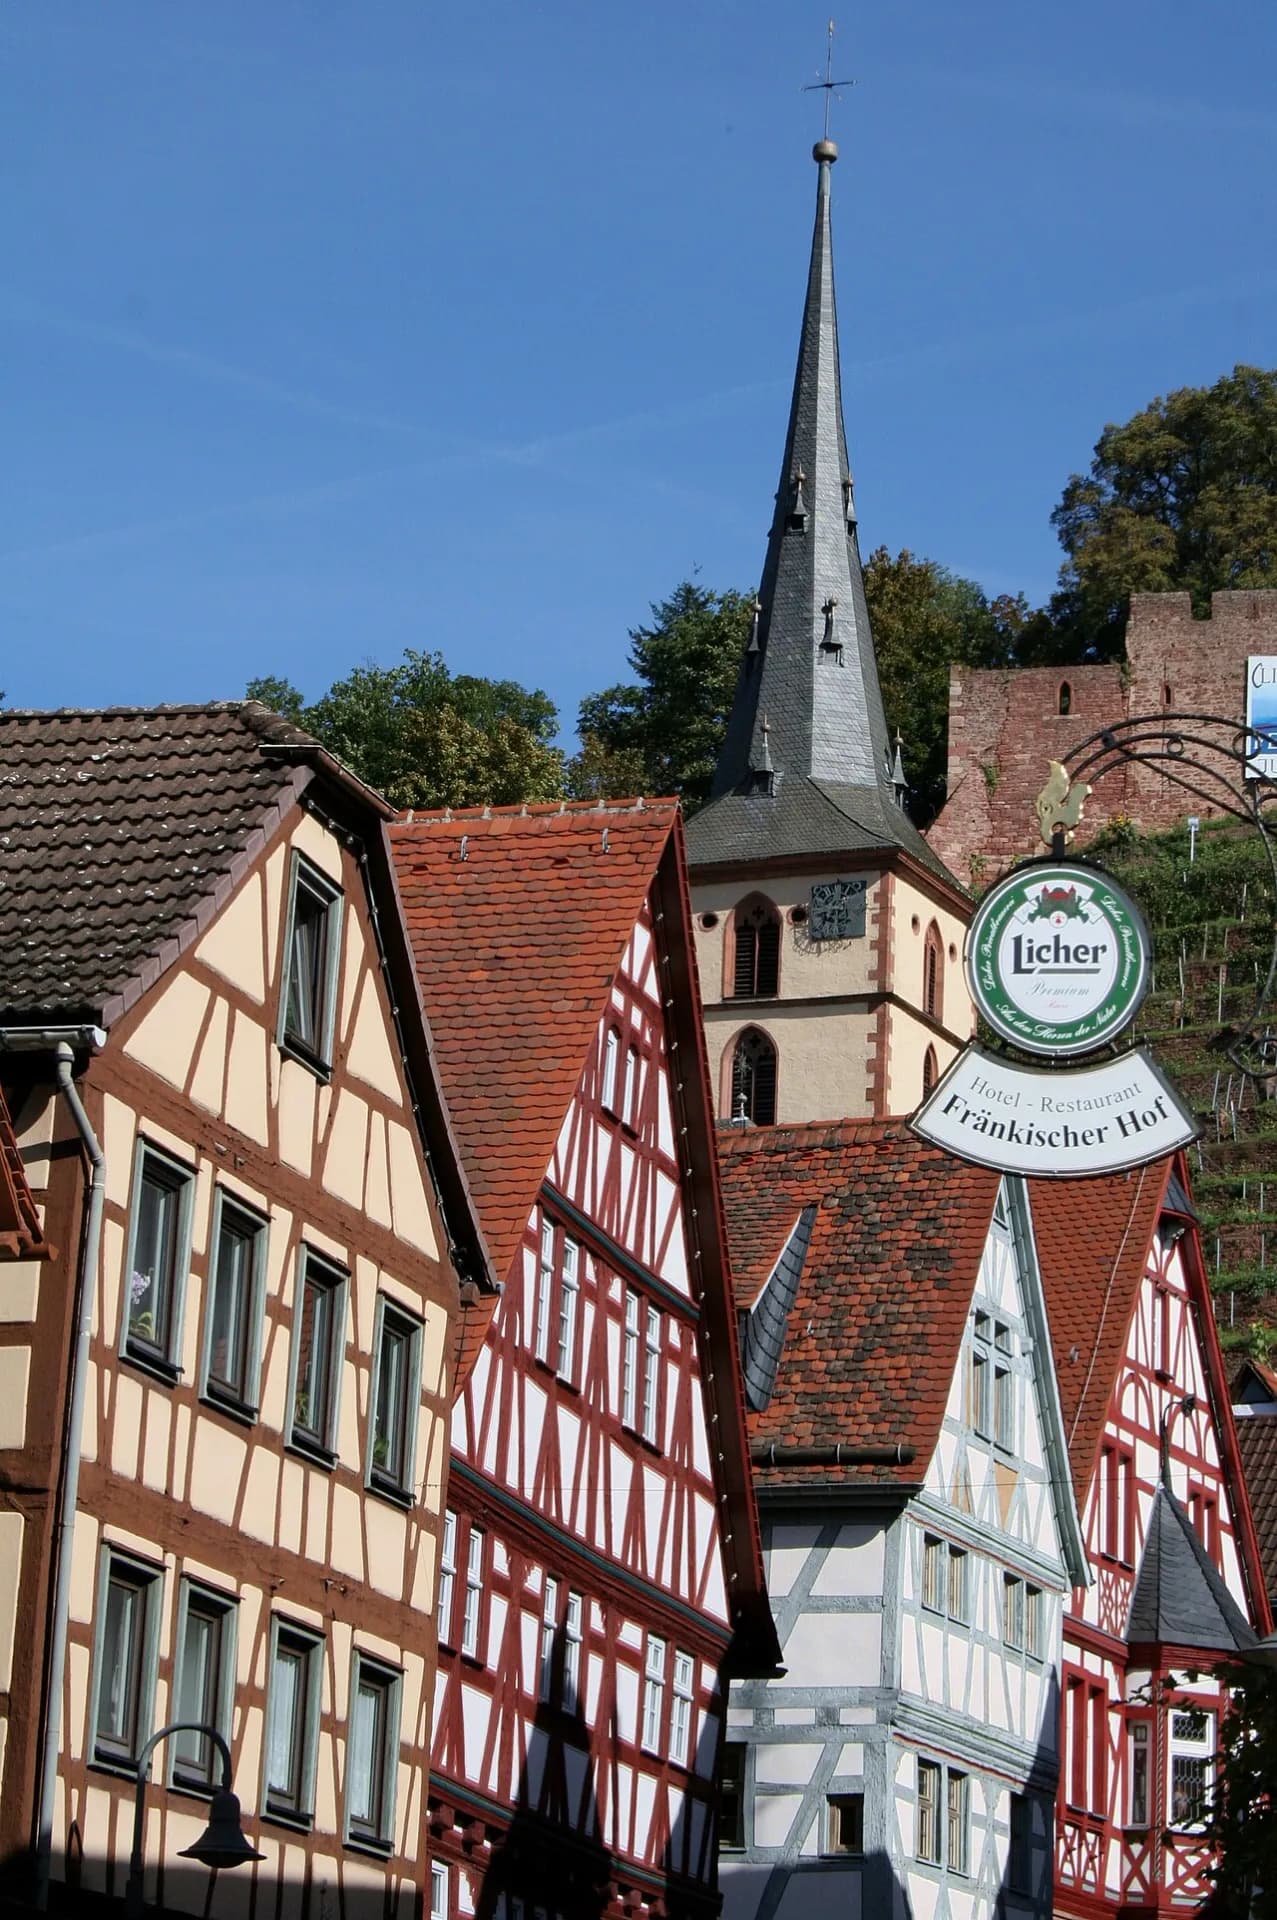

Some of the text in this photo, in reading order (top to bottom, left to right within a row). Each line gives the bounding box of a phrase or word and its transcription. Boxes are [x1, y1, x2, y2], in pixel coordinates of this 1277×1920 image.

[1010, 932, 1108, 975] Licher
[1025, 981, 1089, 996] Premium
[996, 1003, 1016, 1022] Aus
[1013, 1020, 1032, 1033] dem
[1075, 1024, 1090, 1037] der
[1092, 1004, 1117, 1030] Natur
[970, 1076, 1021, 1108] Hotel
[1040, 1081, 1143, 1113] Restaurant
[941, 1093, 1170, 1149] Fränkischer Hof
